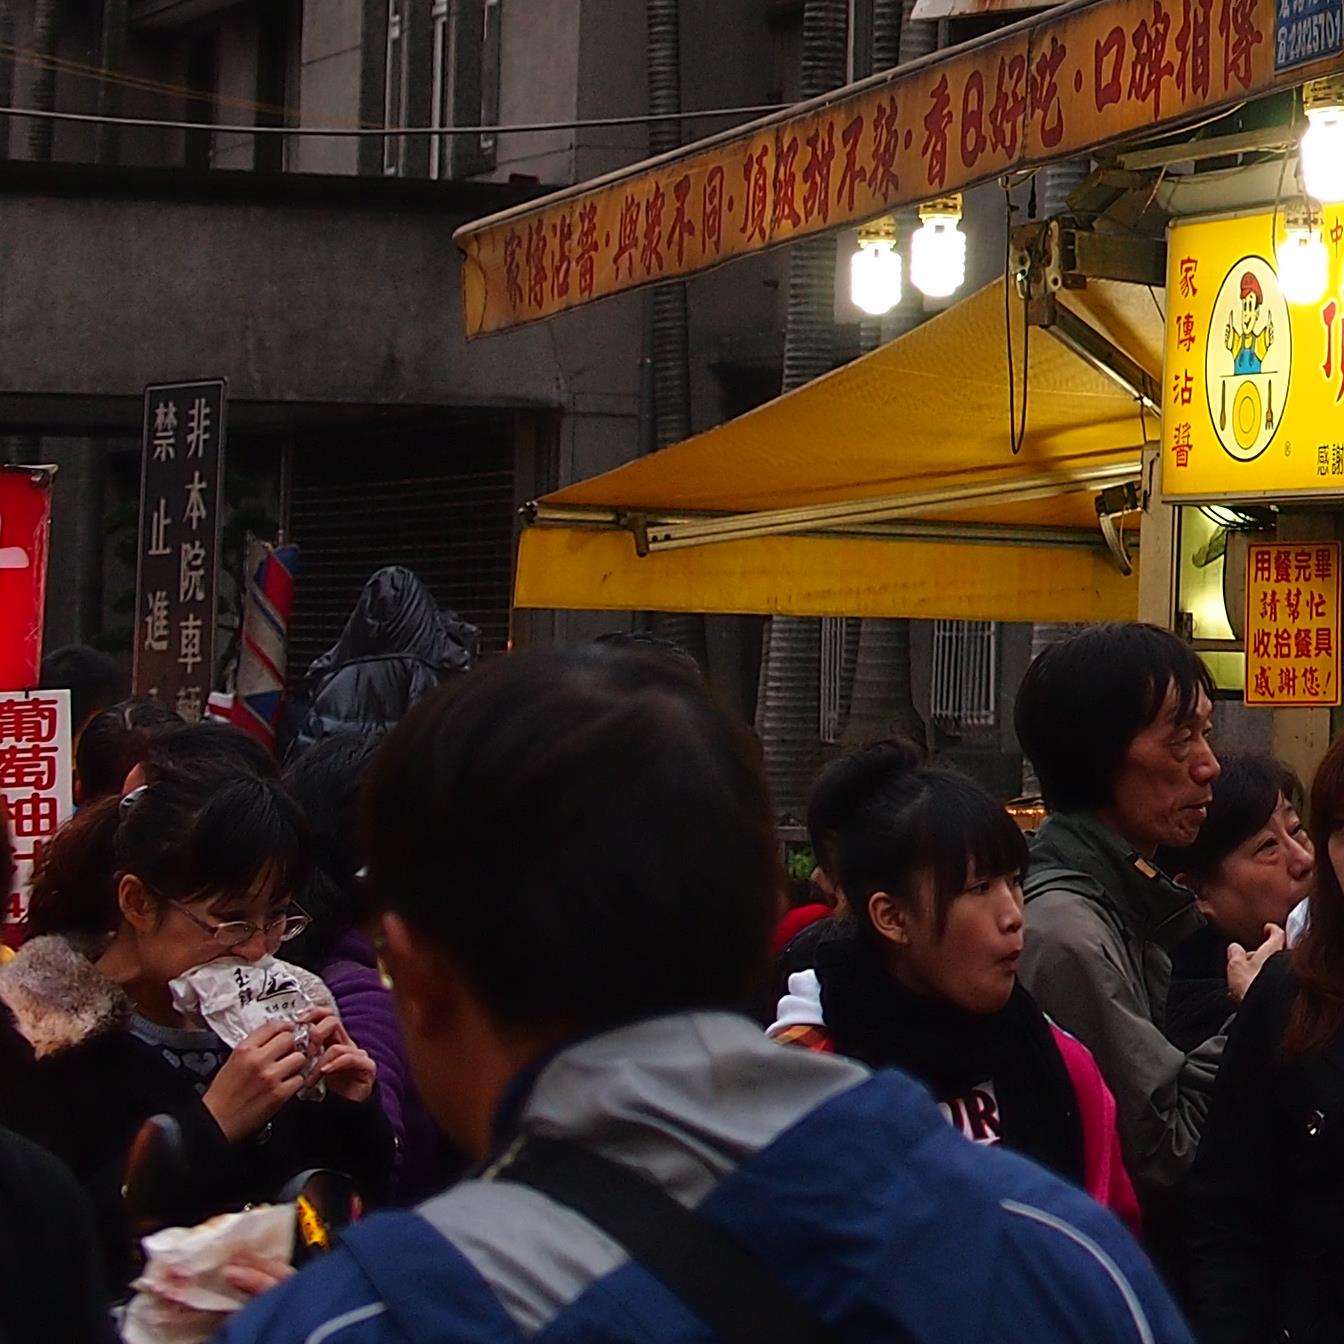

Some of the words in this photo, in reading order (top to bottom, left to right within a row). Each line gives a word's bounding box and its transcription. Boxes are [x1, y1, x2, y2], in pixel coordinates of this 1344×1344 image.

[1170, 256, 1199, 469] 家傳沾醬
[144, 401, 178, 695] 禁止進
[1254, 548, 1332, 584] 用餐完畢
[1260, 587, 1326, 625] 請幫忙
[1253, 627, 1332, 659] 收拾餐具
[1254, 665, 1332, 699] 感謝您!
